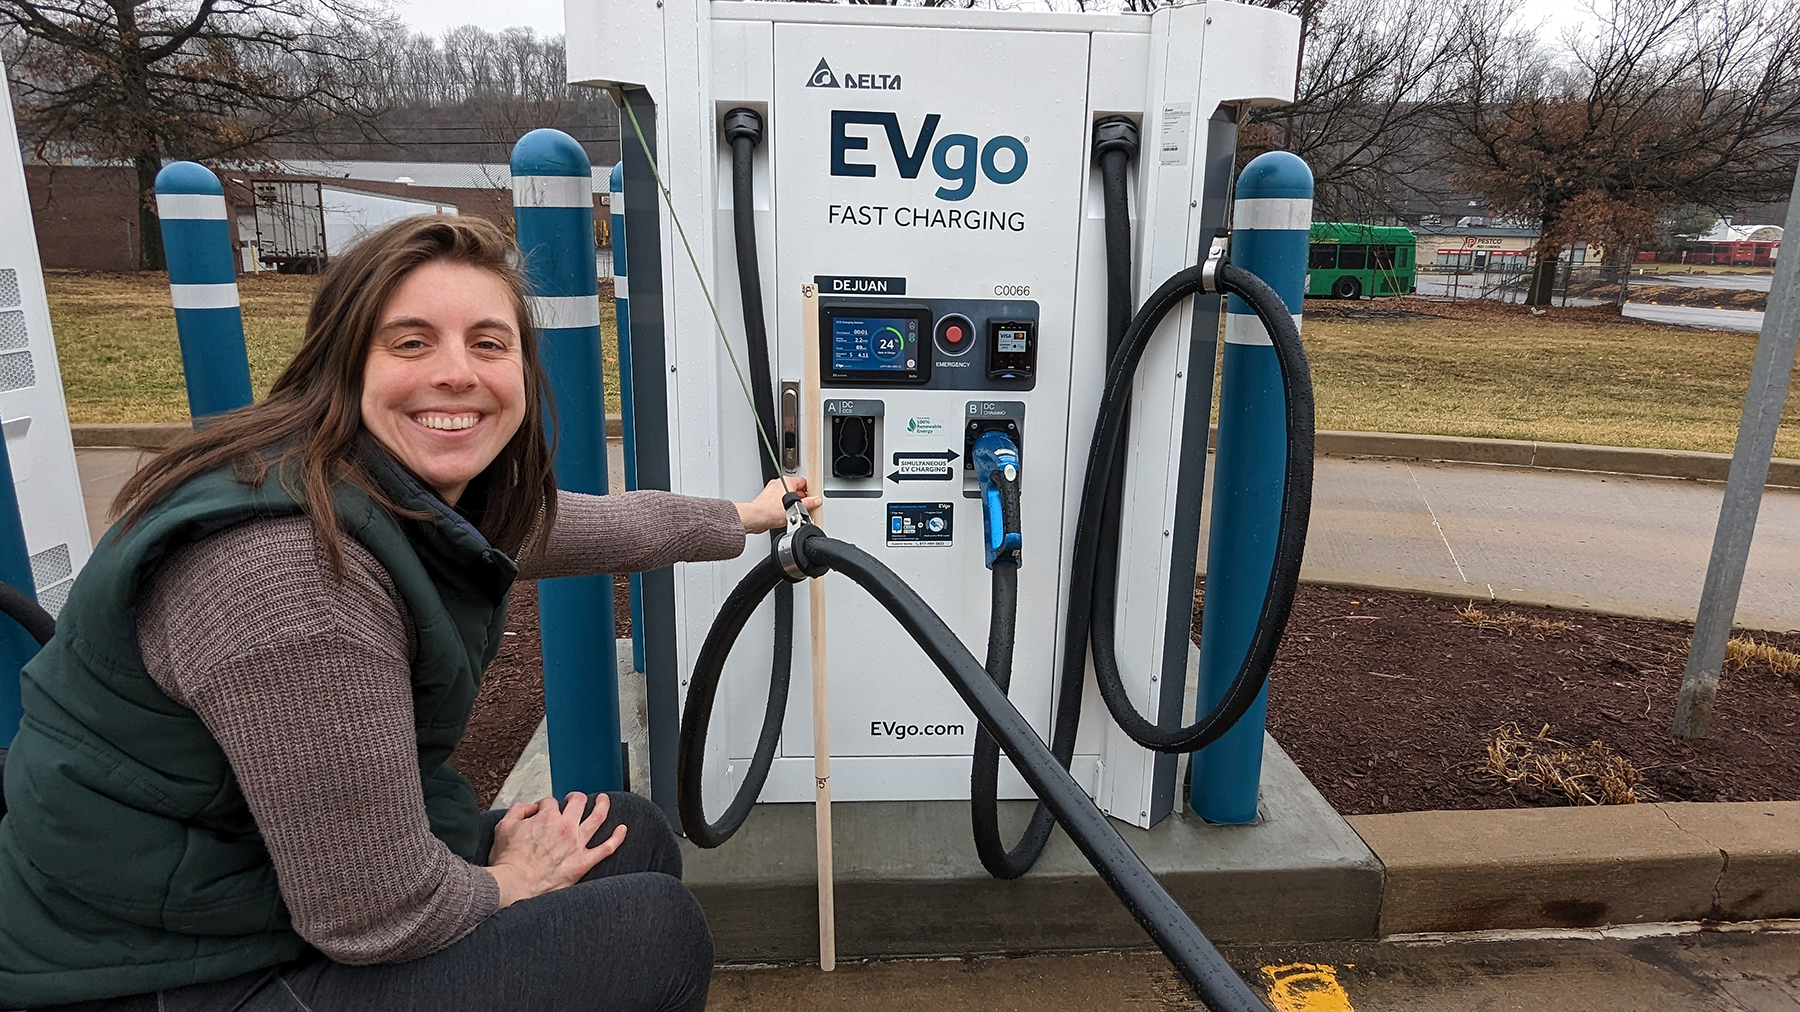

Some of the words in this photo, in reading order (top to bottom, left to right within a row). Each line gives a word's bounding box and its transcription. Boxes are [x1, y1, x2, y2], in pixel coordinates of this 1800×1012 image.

[845, 73, 902, 90] DELTA
[830, 110, 1028, 201] EVgo
[828, 205, 888, 225] FAST
[894, 207, 1025, 231] CHARGING
[833, 279, 887, 292] DEJUAN
[994, 285, 1030, 297] C0066
[880, 339, 894, 349] 24
[828, 402, 836, 412] A
[970, 404, 977, 414] B
[870, 721, 965, 739] EVgo.com
